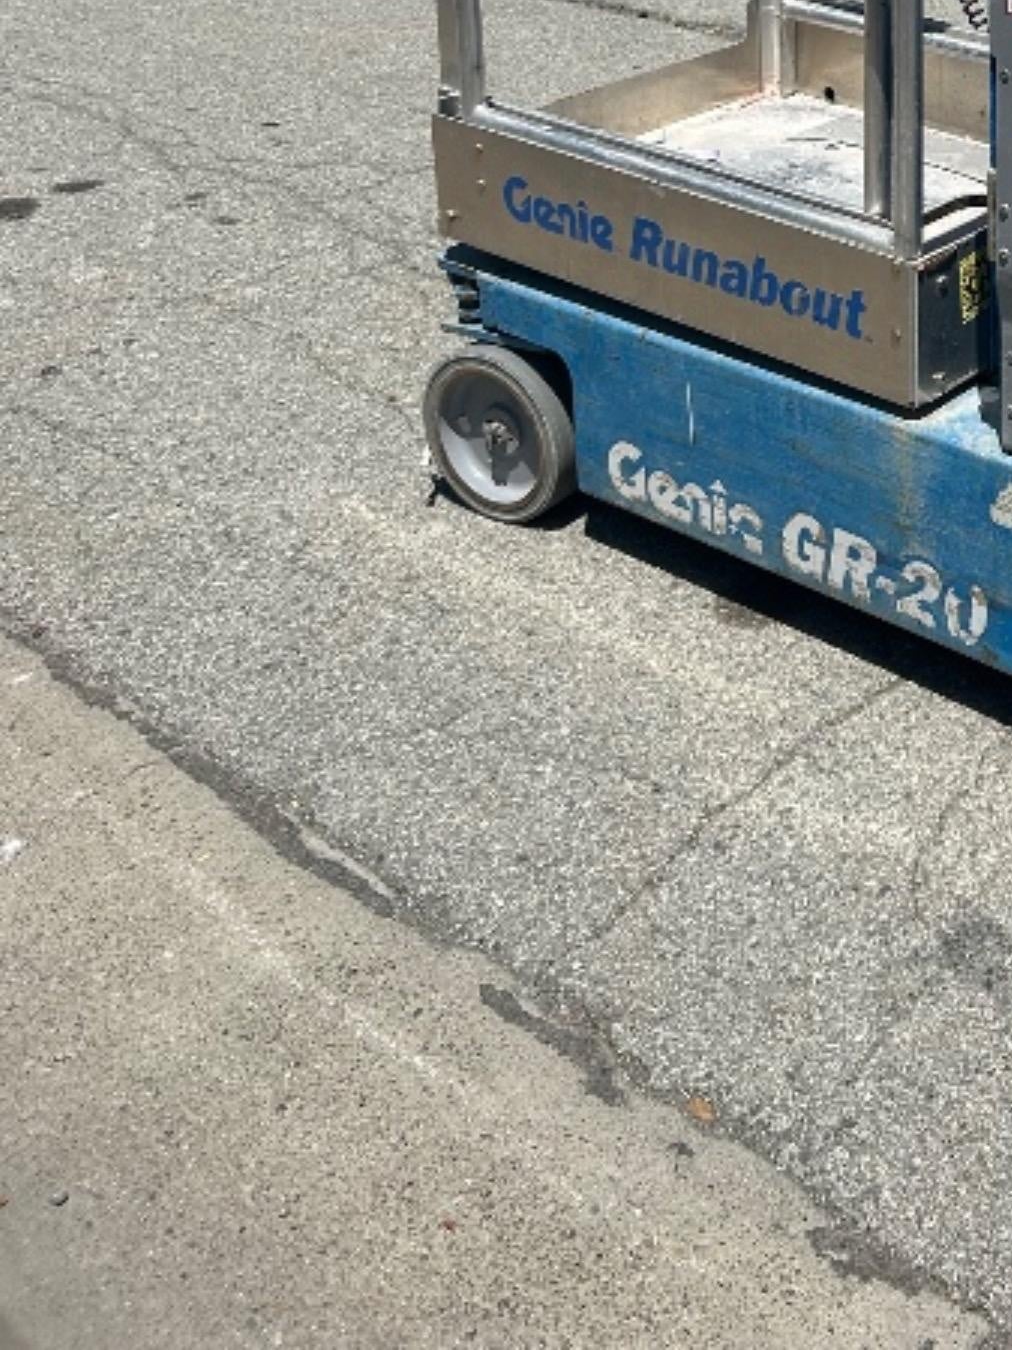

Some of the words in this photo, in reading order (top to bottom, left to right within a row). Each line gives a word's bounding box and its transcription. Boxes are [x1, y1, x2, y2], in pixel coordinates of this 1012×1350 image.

[502, 175, 615, 254] Genie
[629, 215, 867, 340] Runabout
[781, 511, 989, 647] GR-20
